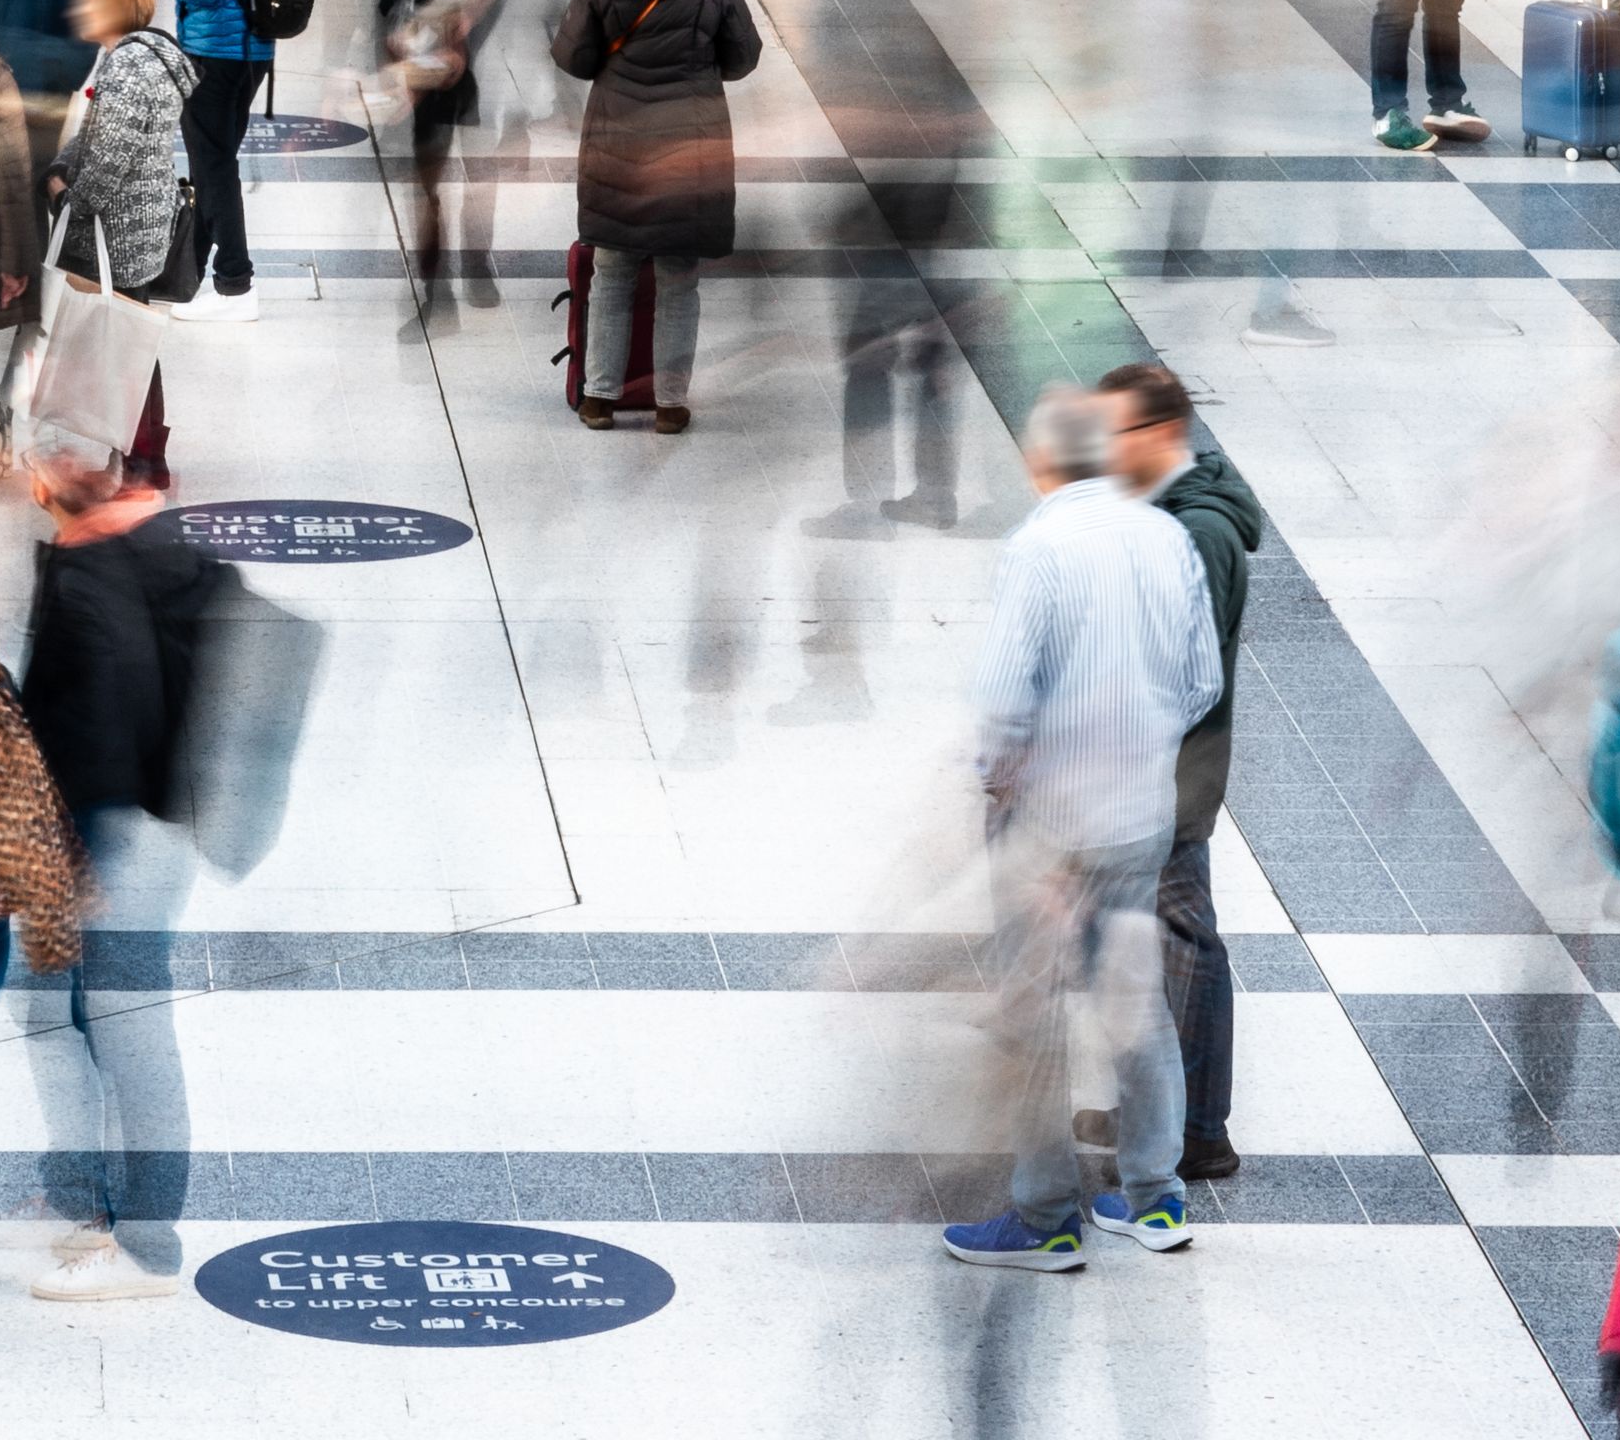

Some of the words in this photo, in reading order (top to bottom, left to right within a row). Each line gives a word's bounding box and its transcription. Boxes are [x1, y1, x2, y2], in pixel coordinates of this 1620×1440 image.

[179, 511, 424, 525] Customer
[182, 524, 267, 535] Lift
[208, 537, 288, 547] upper
[295, 536, 436, 545] concourse
[259, 1250, 598, 1270] Customer
[267, 1272, 388, 1291] Lift
[255, 1298, 296, 1309] to
[308, 1298, 418, 1310] upper
[429, 1297, 626, 1307] concourse
